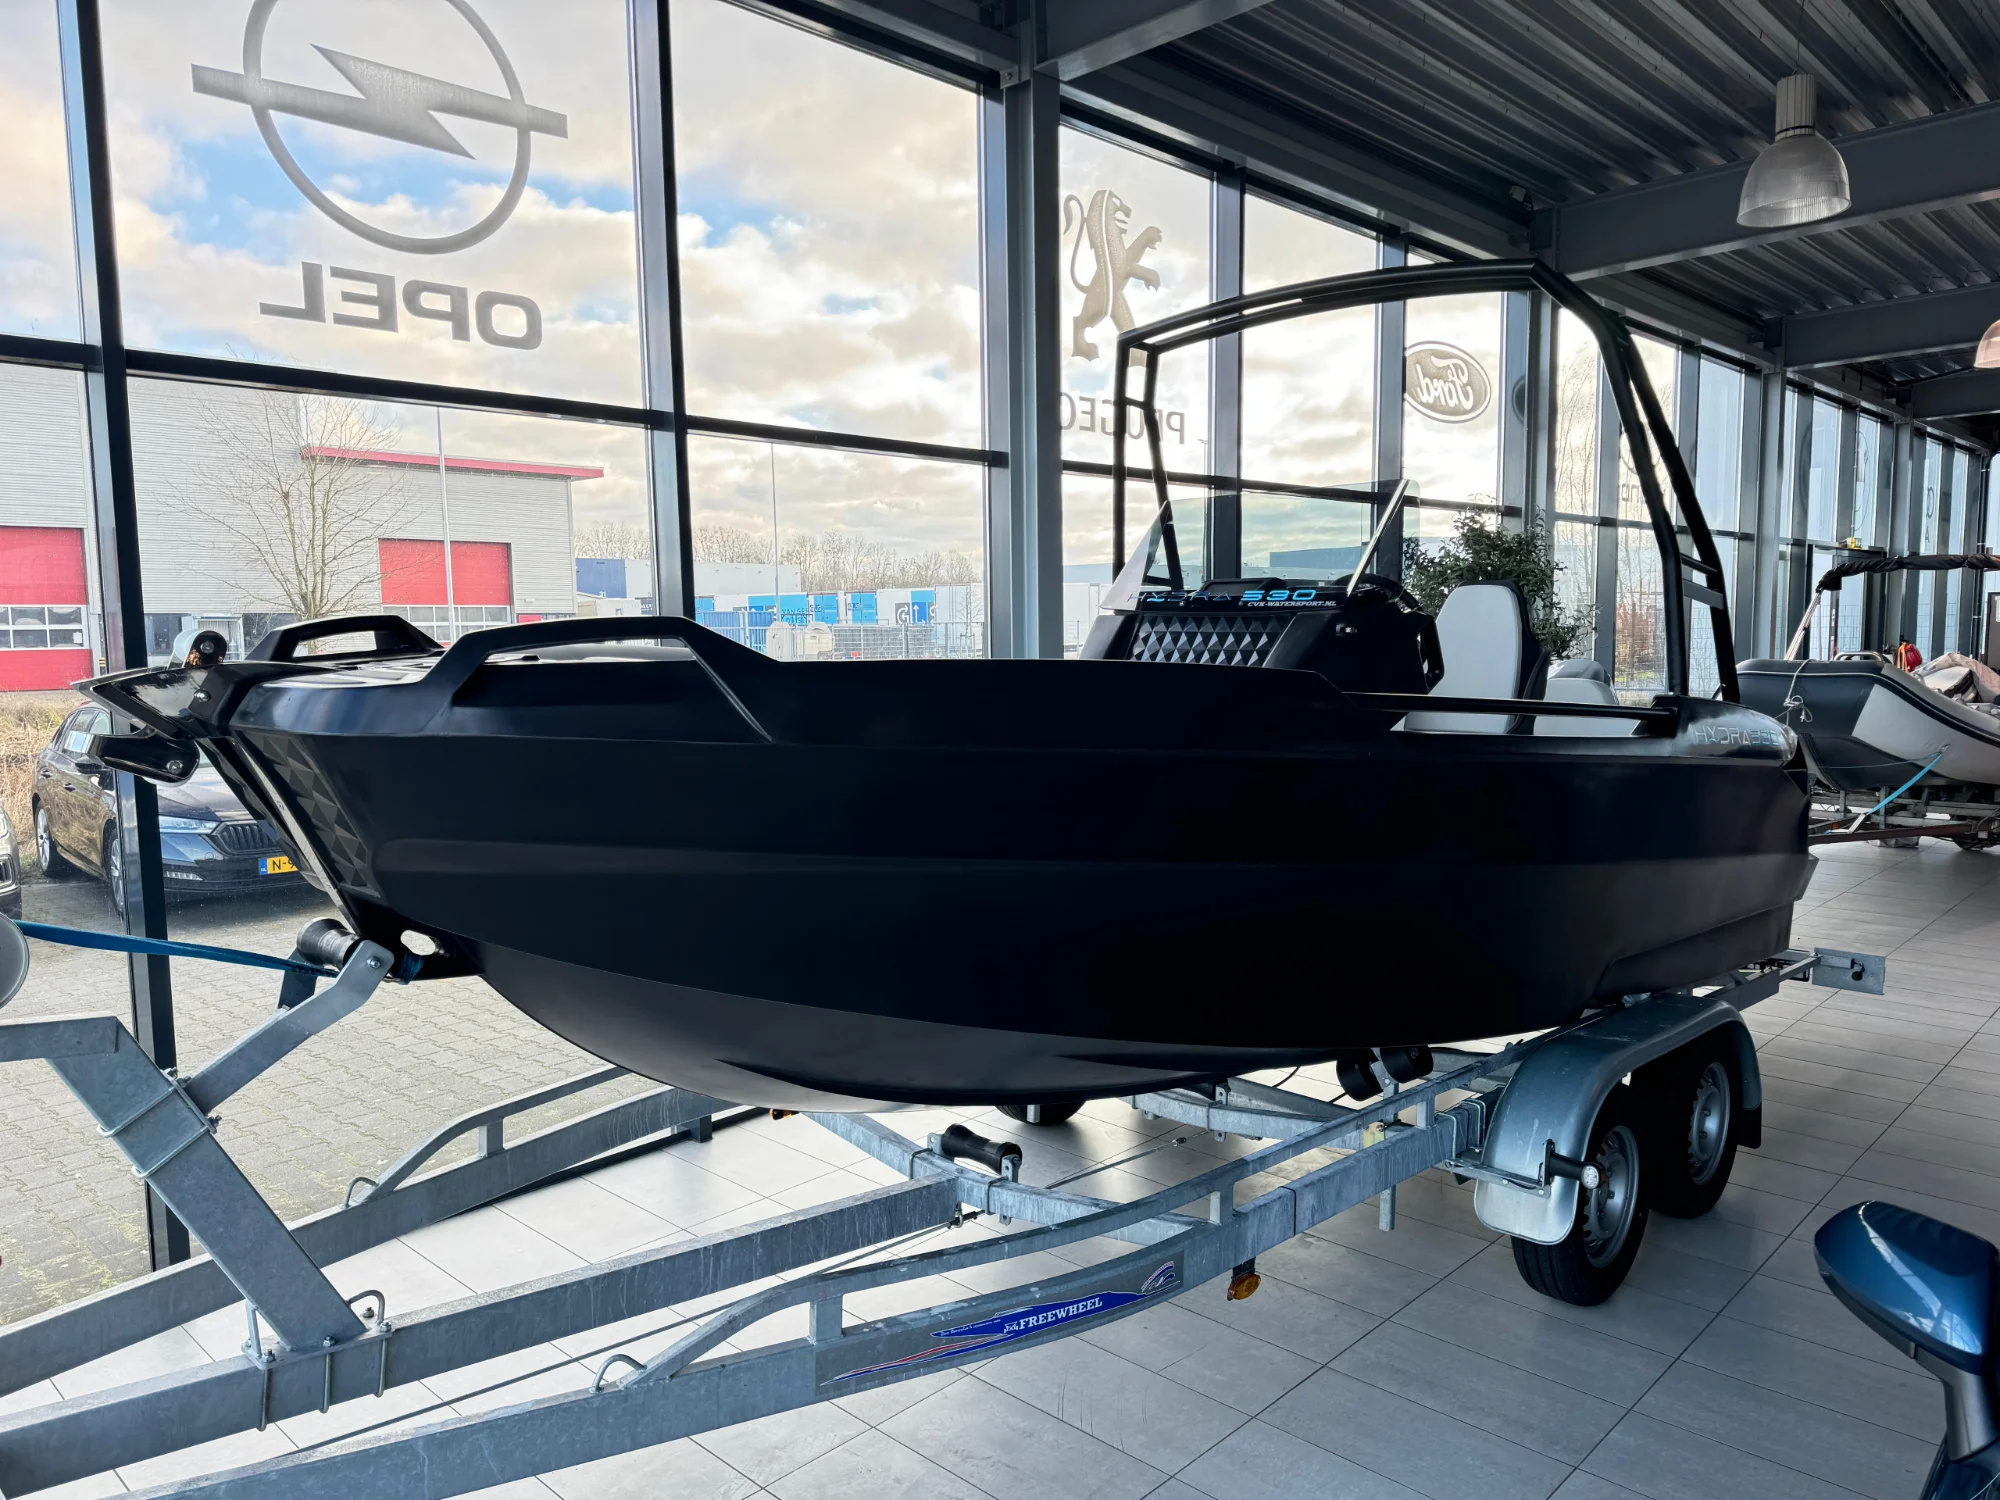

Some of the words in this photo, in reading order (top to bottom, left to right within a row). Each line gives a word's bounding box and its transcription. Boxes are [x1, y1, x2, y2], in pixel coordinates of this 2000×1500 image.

[1241, 590, 1317, 601] 530
[1694, 726, 1750, 745] HYDRA
[1019, 1297, 1102, 1330] FREEWHEEL
